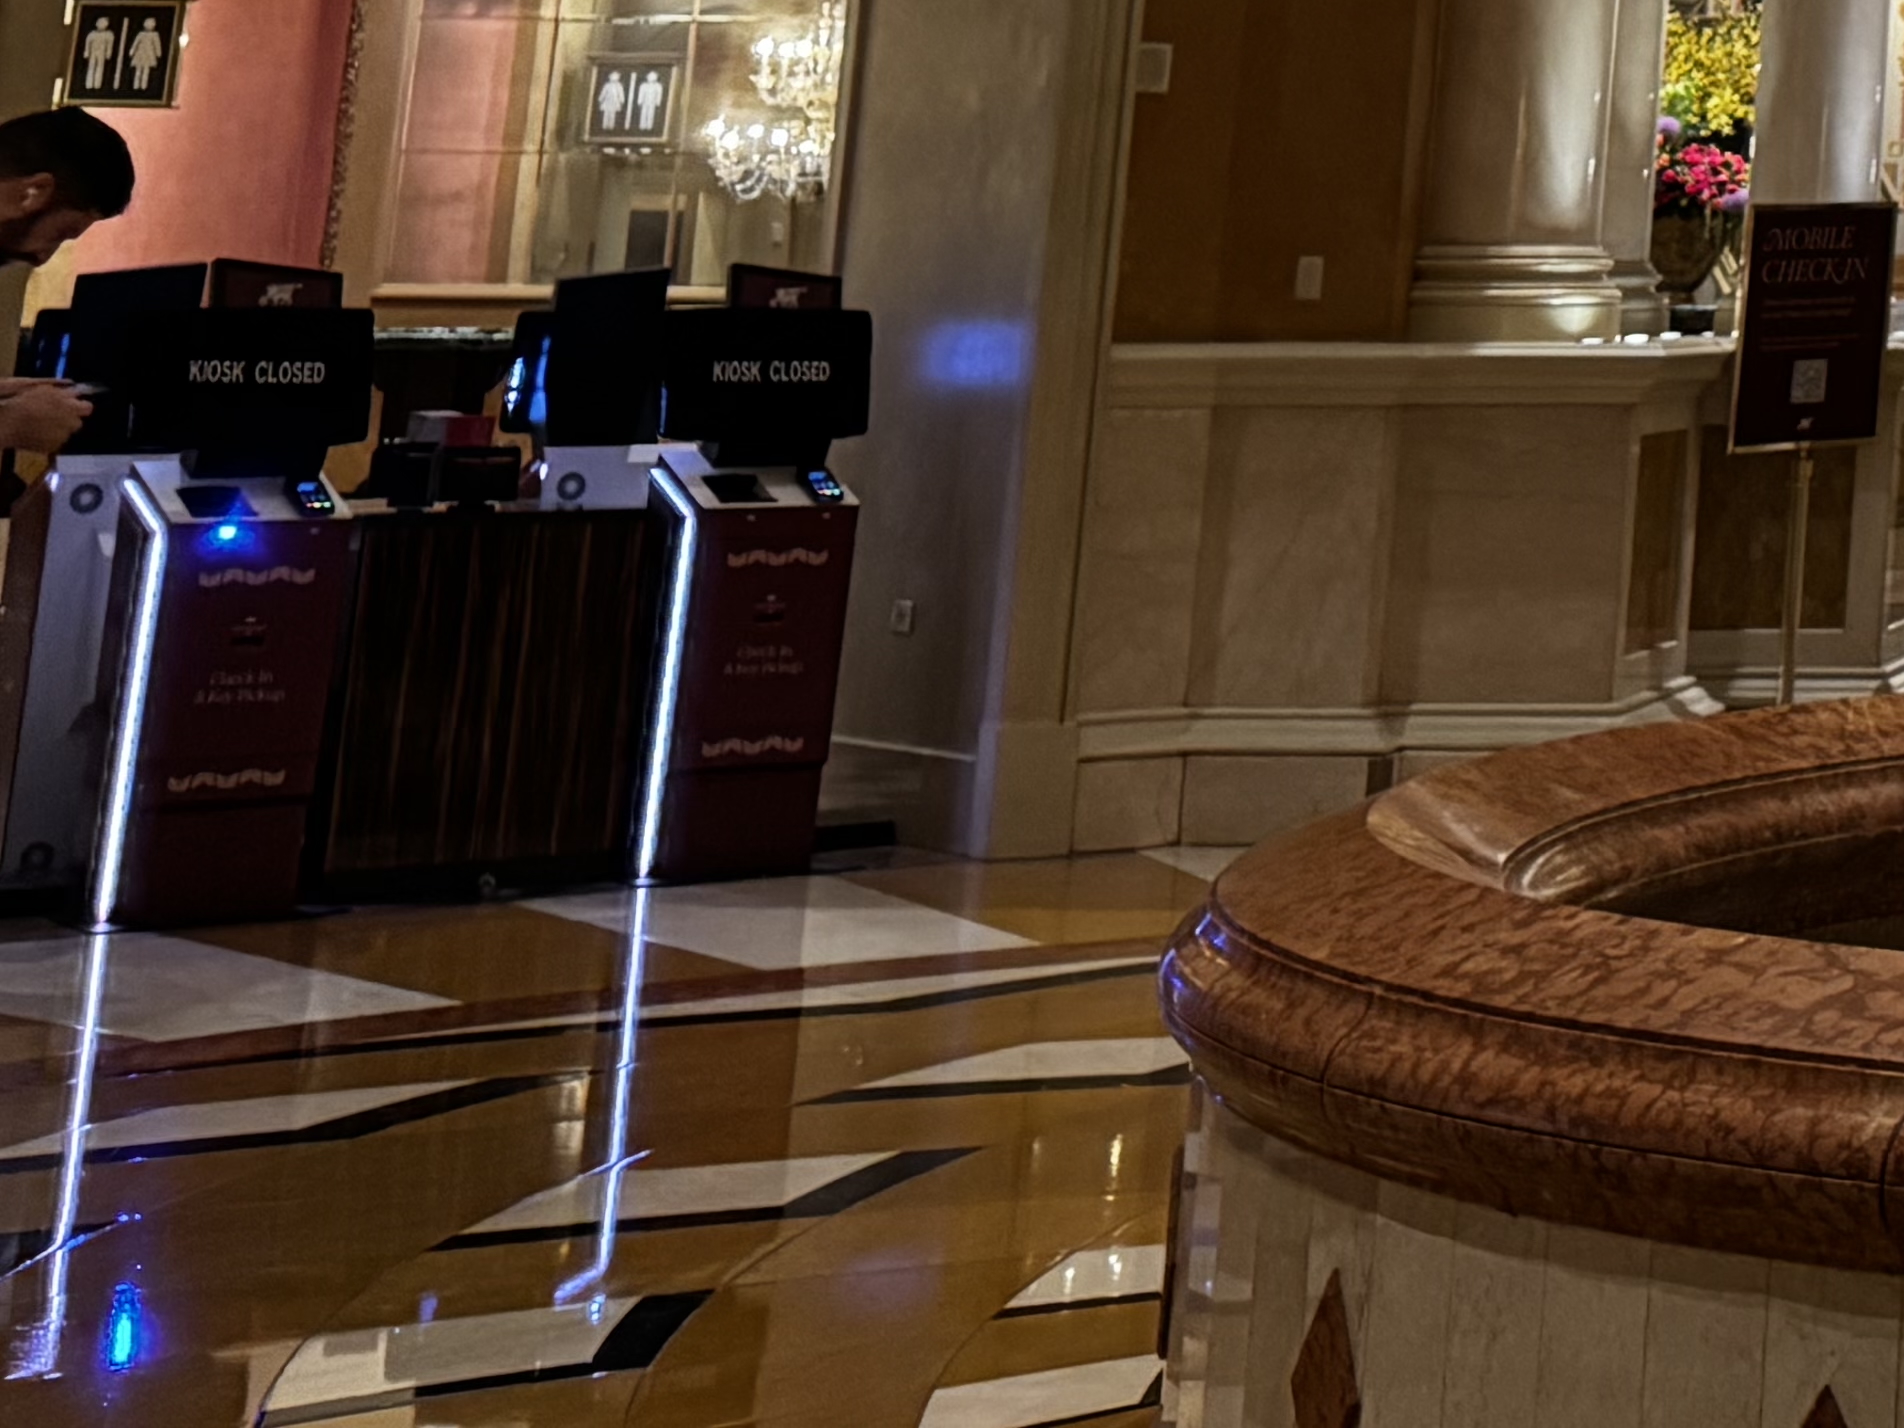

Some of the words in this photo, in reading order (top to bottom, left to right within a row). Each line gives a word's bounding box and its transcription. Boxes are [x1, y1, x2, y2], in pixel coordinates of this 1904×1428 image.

[1762, 225, 1857, 252] MOBILE
[189, 359, 246, 383] KIOSK
[254, 360, 326, 385] CLOSED
[713, 359, 762, 383] KIOSK
[769, 359, 831, 383] CLOSED
